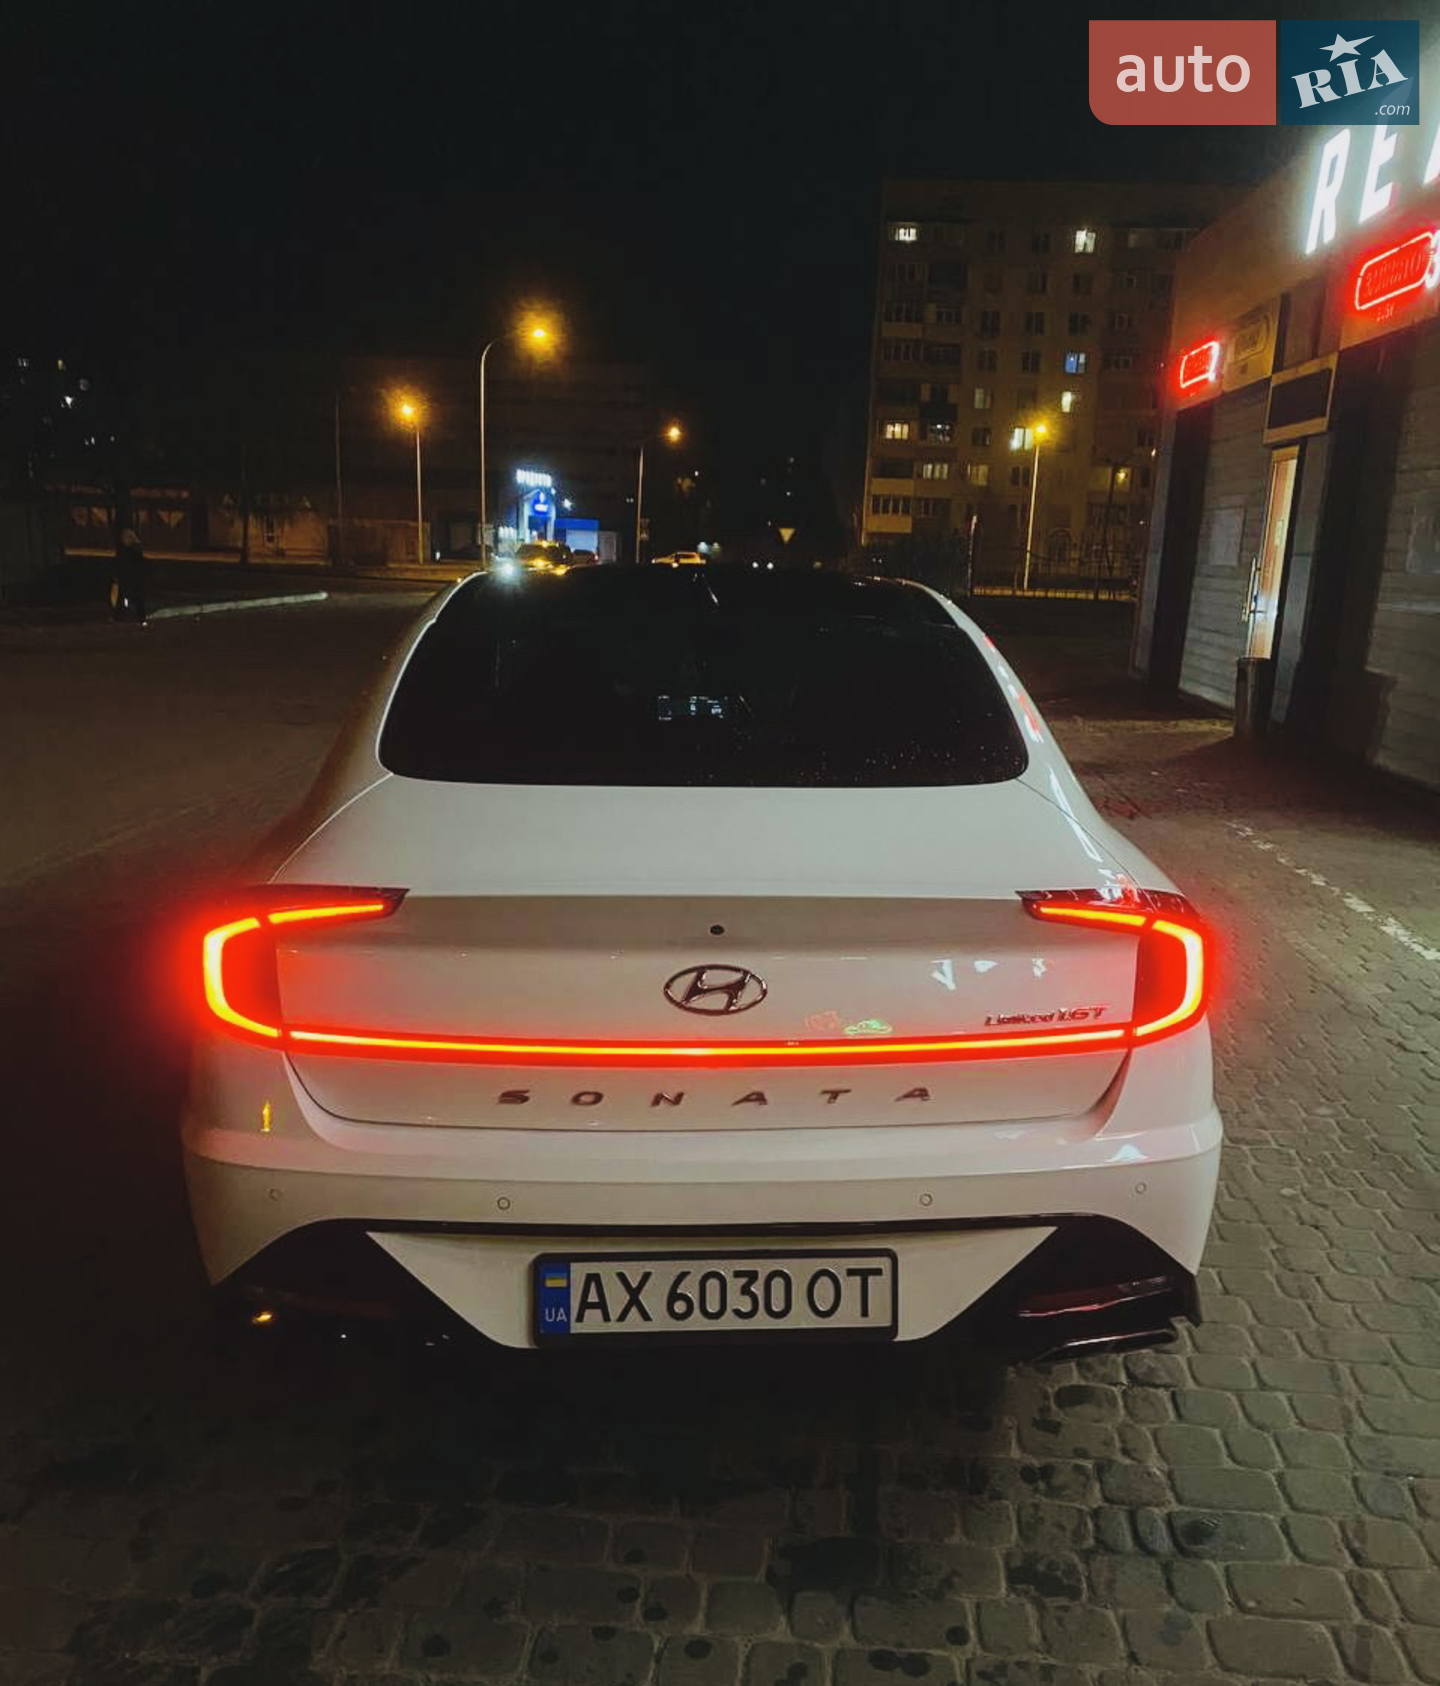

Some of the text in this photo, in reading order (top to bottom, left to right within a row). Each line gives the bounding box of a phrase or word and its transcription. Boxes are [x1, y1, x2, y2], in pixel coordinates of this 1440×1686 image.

[496, 1087, 933, 1108] SONATA
[574, 1266, 884, 1323] AX 6030 OT
[544, 1307, 568, 1324] UA
